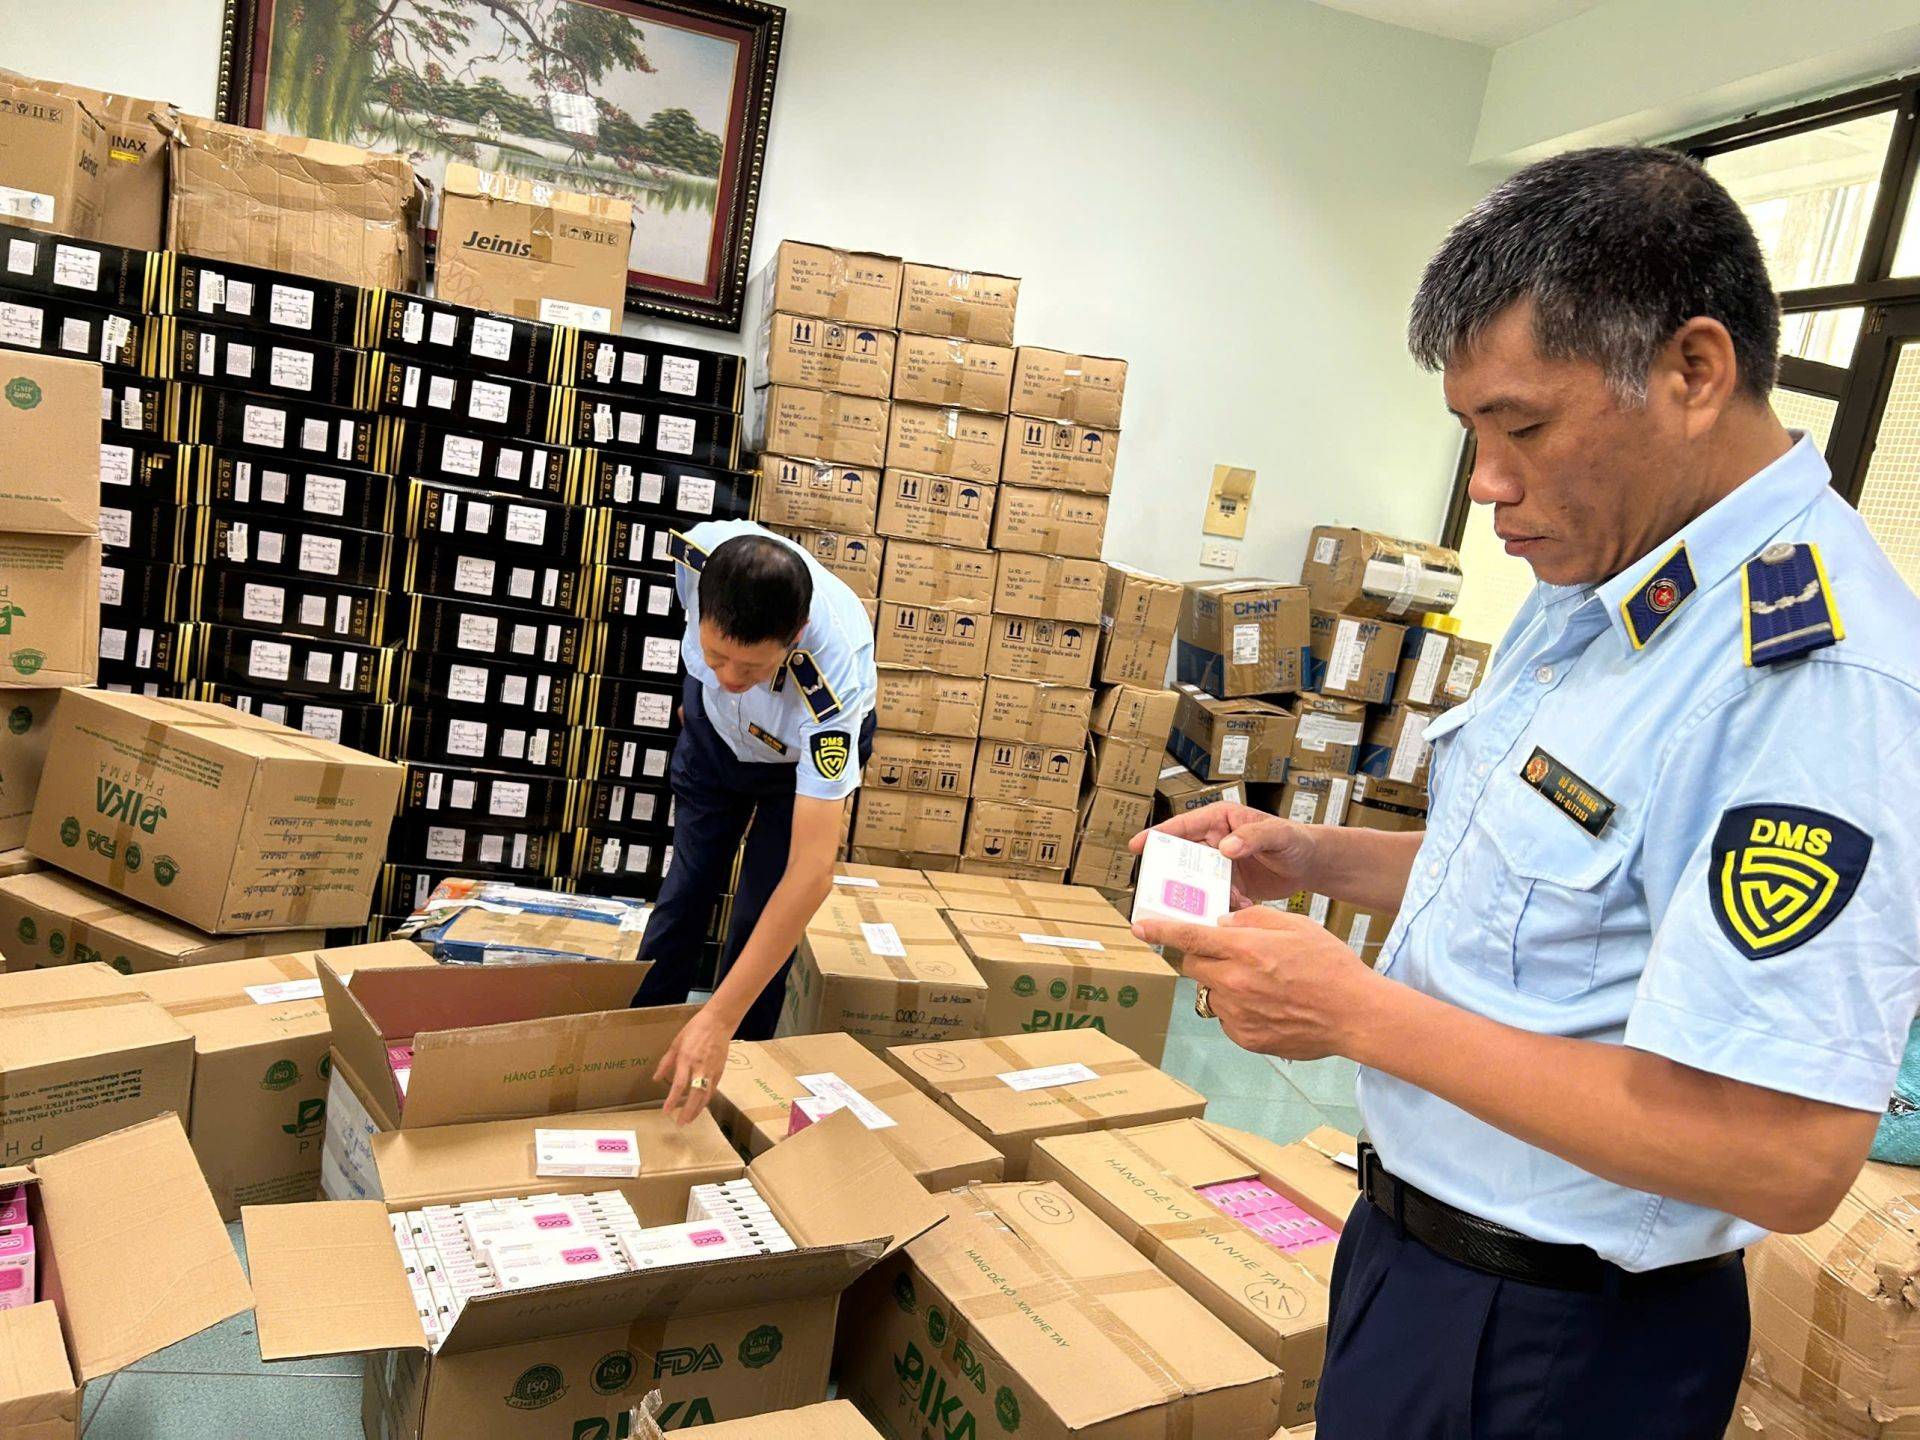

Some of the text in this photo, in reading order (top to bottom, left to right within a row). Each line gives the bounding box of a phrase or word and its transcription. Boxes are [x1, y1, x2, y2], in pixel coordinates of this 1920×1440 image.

[111, 135, 147, 153] INAX
[462, 231, 532, 257] Jeinis
[820, 736, 844, 747] DMS
[1749, 818, 1833, 858] DMS
[1076, 984, 1109, 1003] FDA
[653, 1343, 724, 1379] FDA
[953, 1337, 986, 1394] FDA
[603, 1364, 626, 1378] ISO
[526, 1380, 549, 1394] ISO
